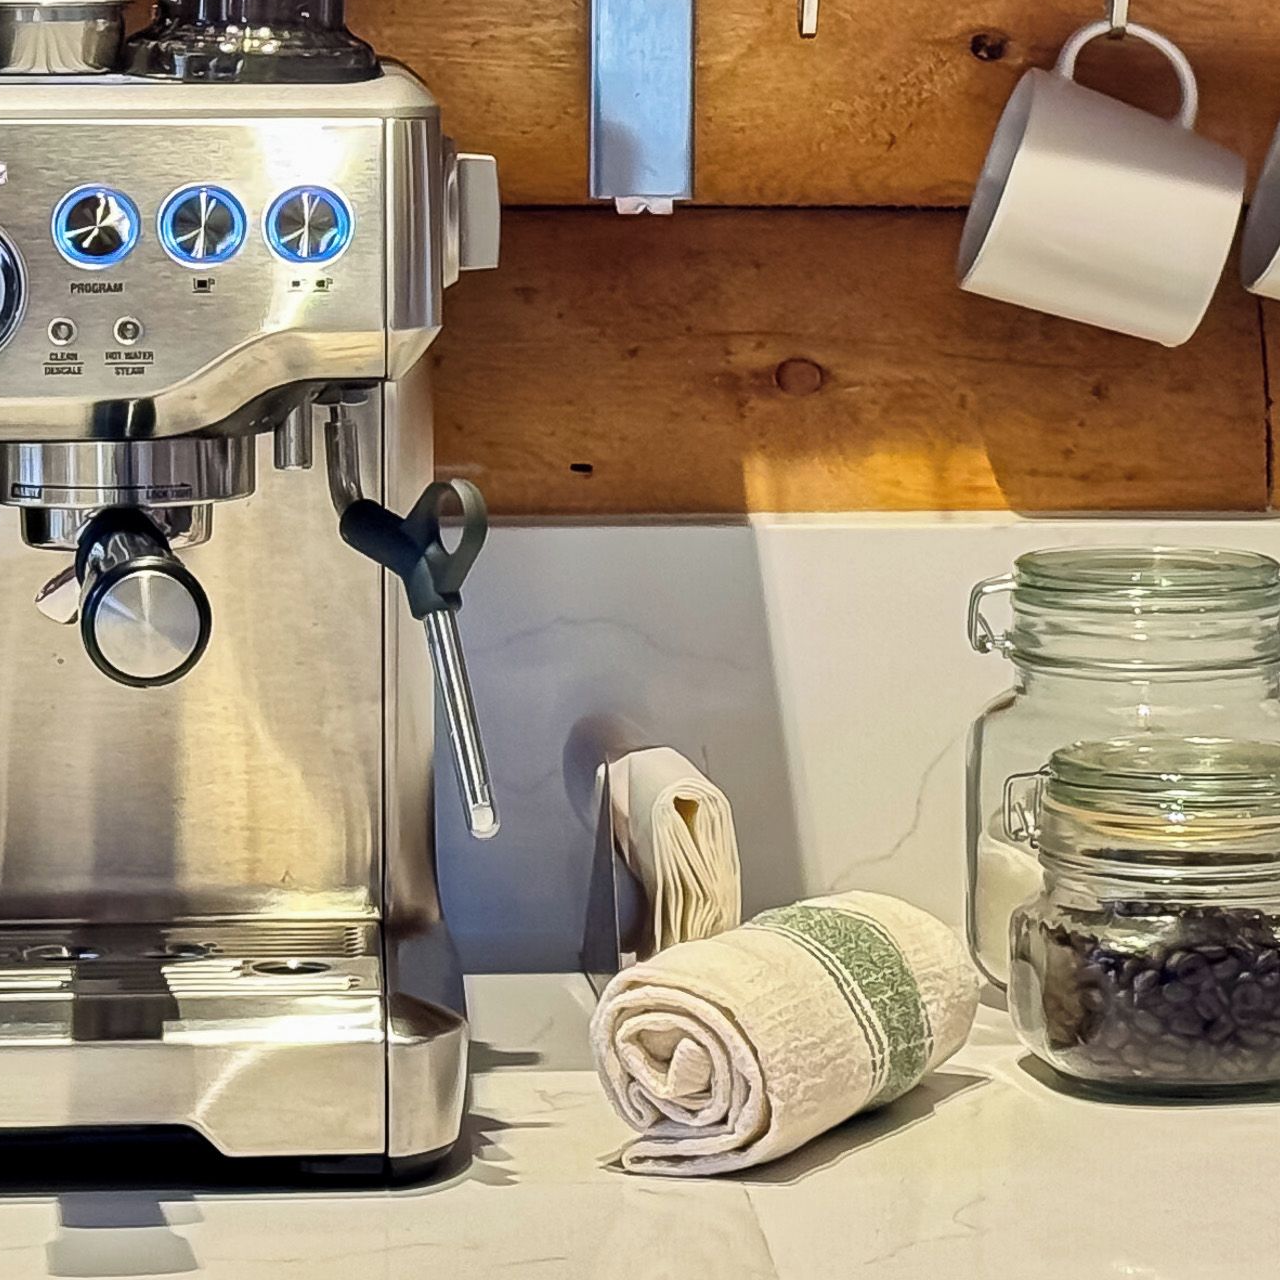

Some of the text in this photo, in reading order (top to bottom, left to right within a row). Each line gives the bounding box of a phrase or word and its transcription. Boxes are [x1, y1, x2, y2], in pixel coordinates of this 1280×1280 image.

[70, 282, 123, 294] PROGRAM
[48, 352, 79, 361] CLEAN
[104, 350, 155, 361] HOT WATER
[114, 366, 146, 376] STEAM
